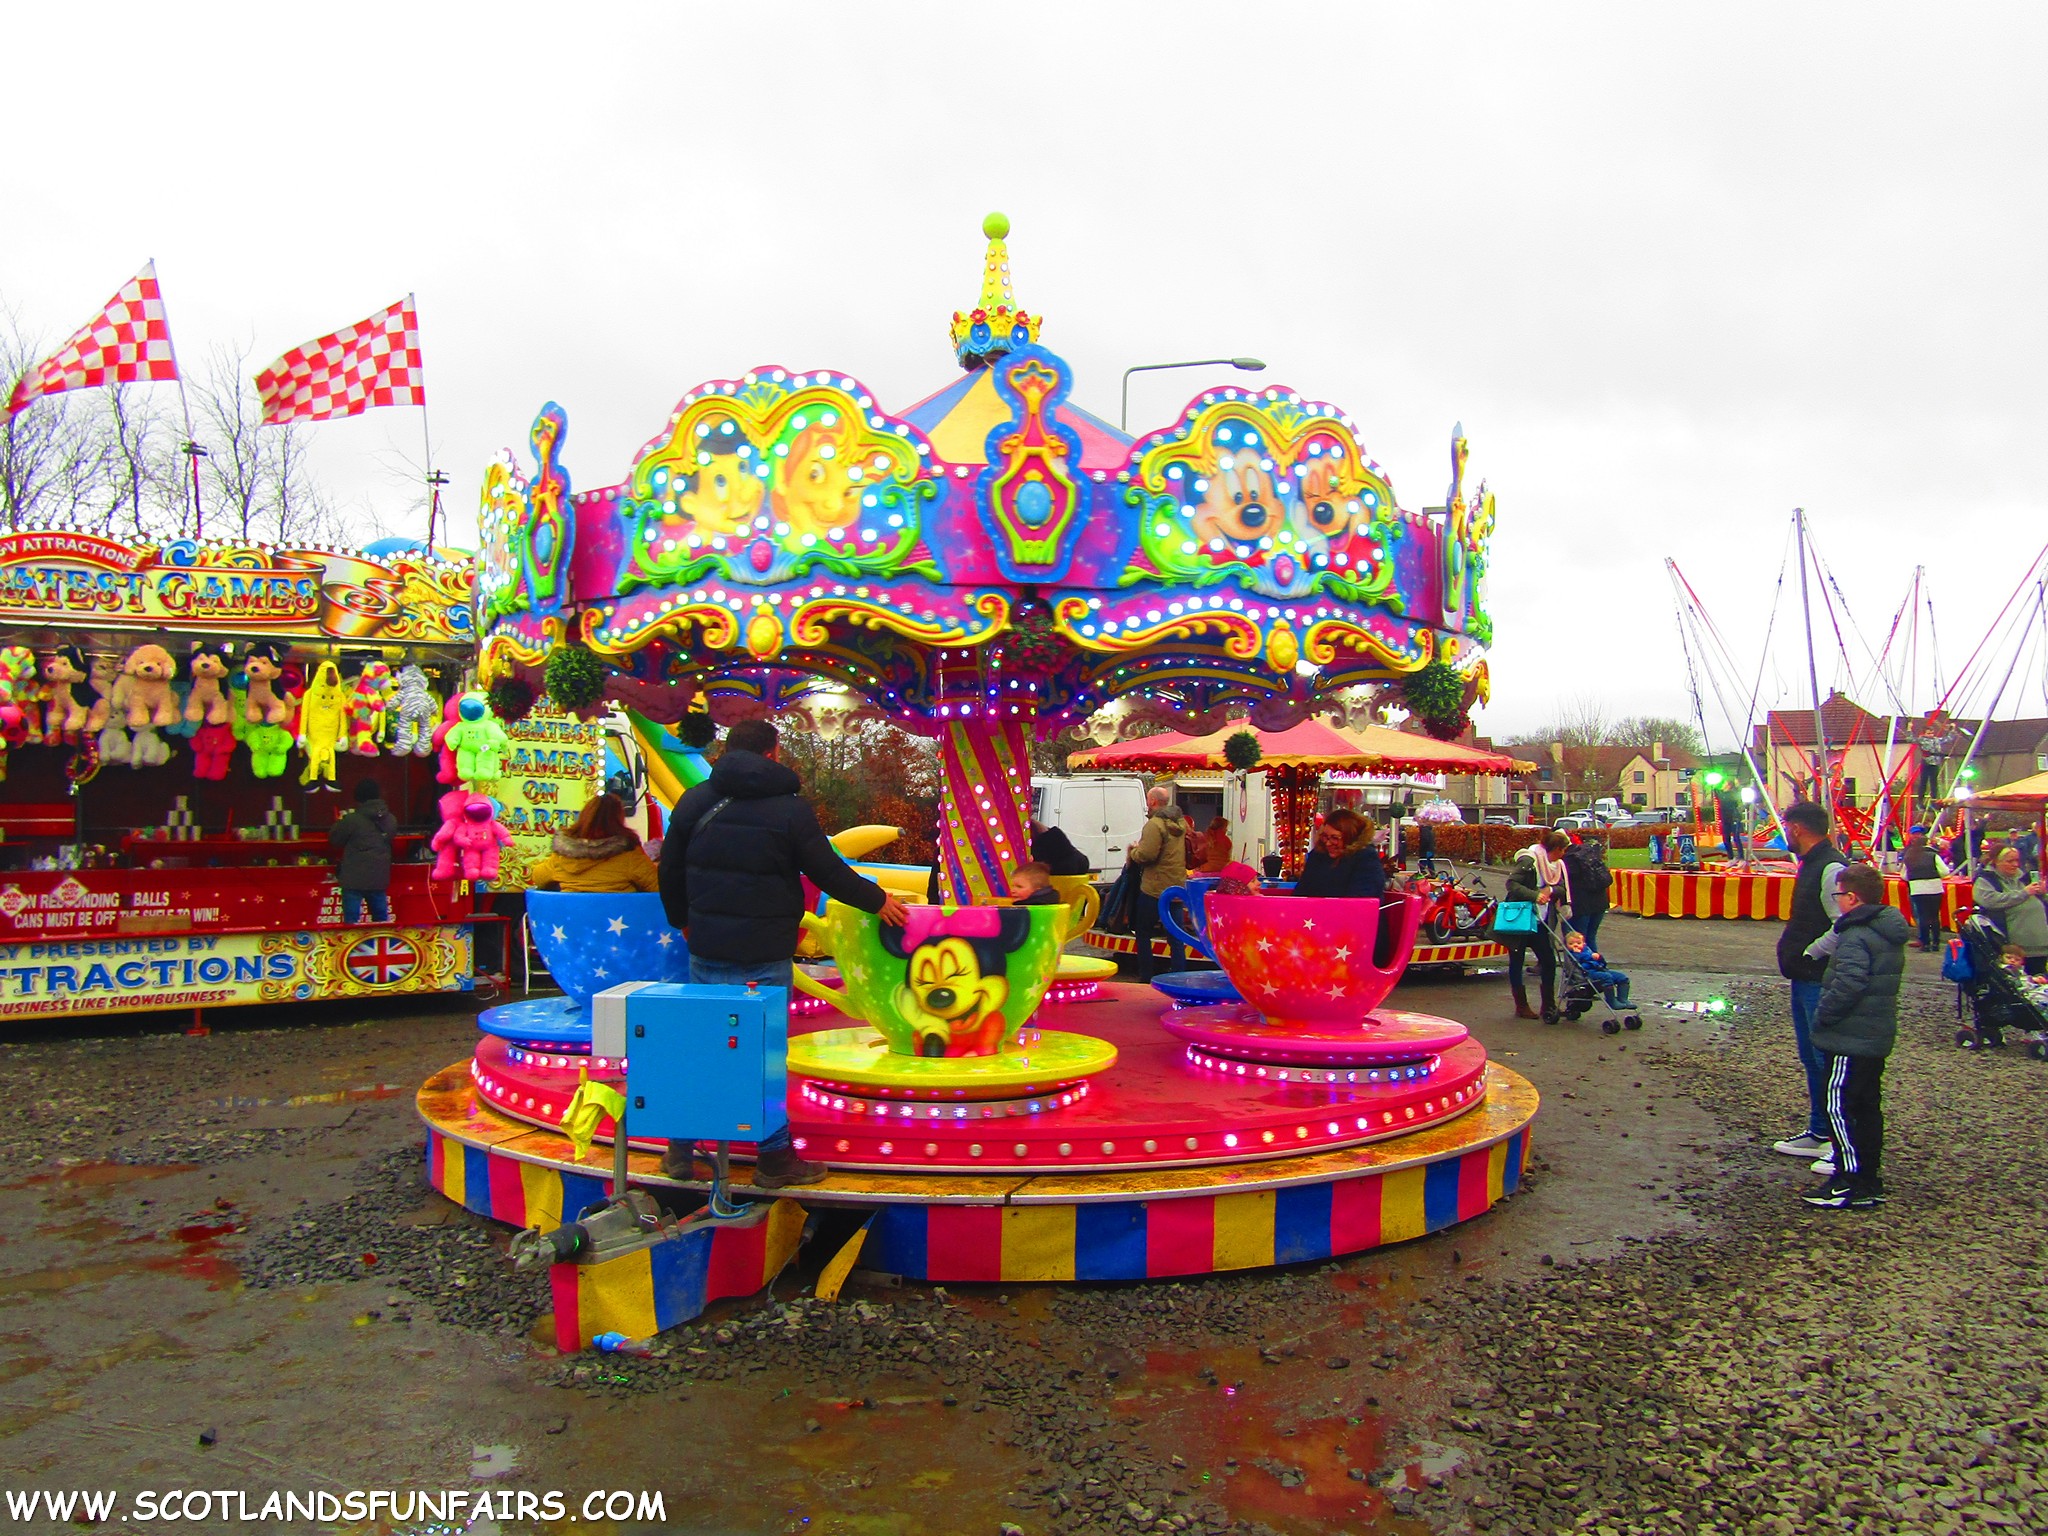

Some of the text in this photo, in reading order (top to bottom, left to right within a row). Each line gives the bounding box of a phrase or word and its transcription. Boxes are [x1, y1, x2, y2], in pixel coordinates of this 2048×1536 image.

[22, 537, 138, 568] ATTRACTIONS
[0, 567, 318, 617] ATEST GAMES
[523, 779, 560, 804] ON
[133, 891, 170, 907] BALLS
[15, 913, 44, 928] CANS
[46, 912, 76, 927] MUST
[78, 911, 93, 926] BE
[95, 910, 117, 926] OFF
[30, 937, 180, 960] PRESENTED
[187, 936, 218, 952] BY
[0, 999, 70, 1015] USINESS
[72, 997, 107, 1011] LIKE
